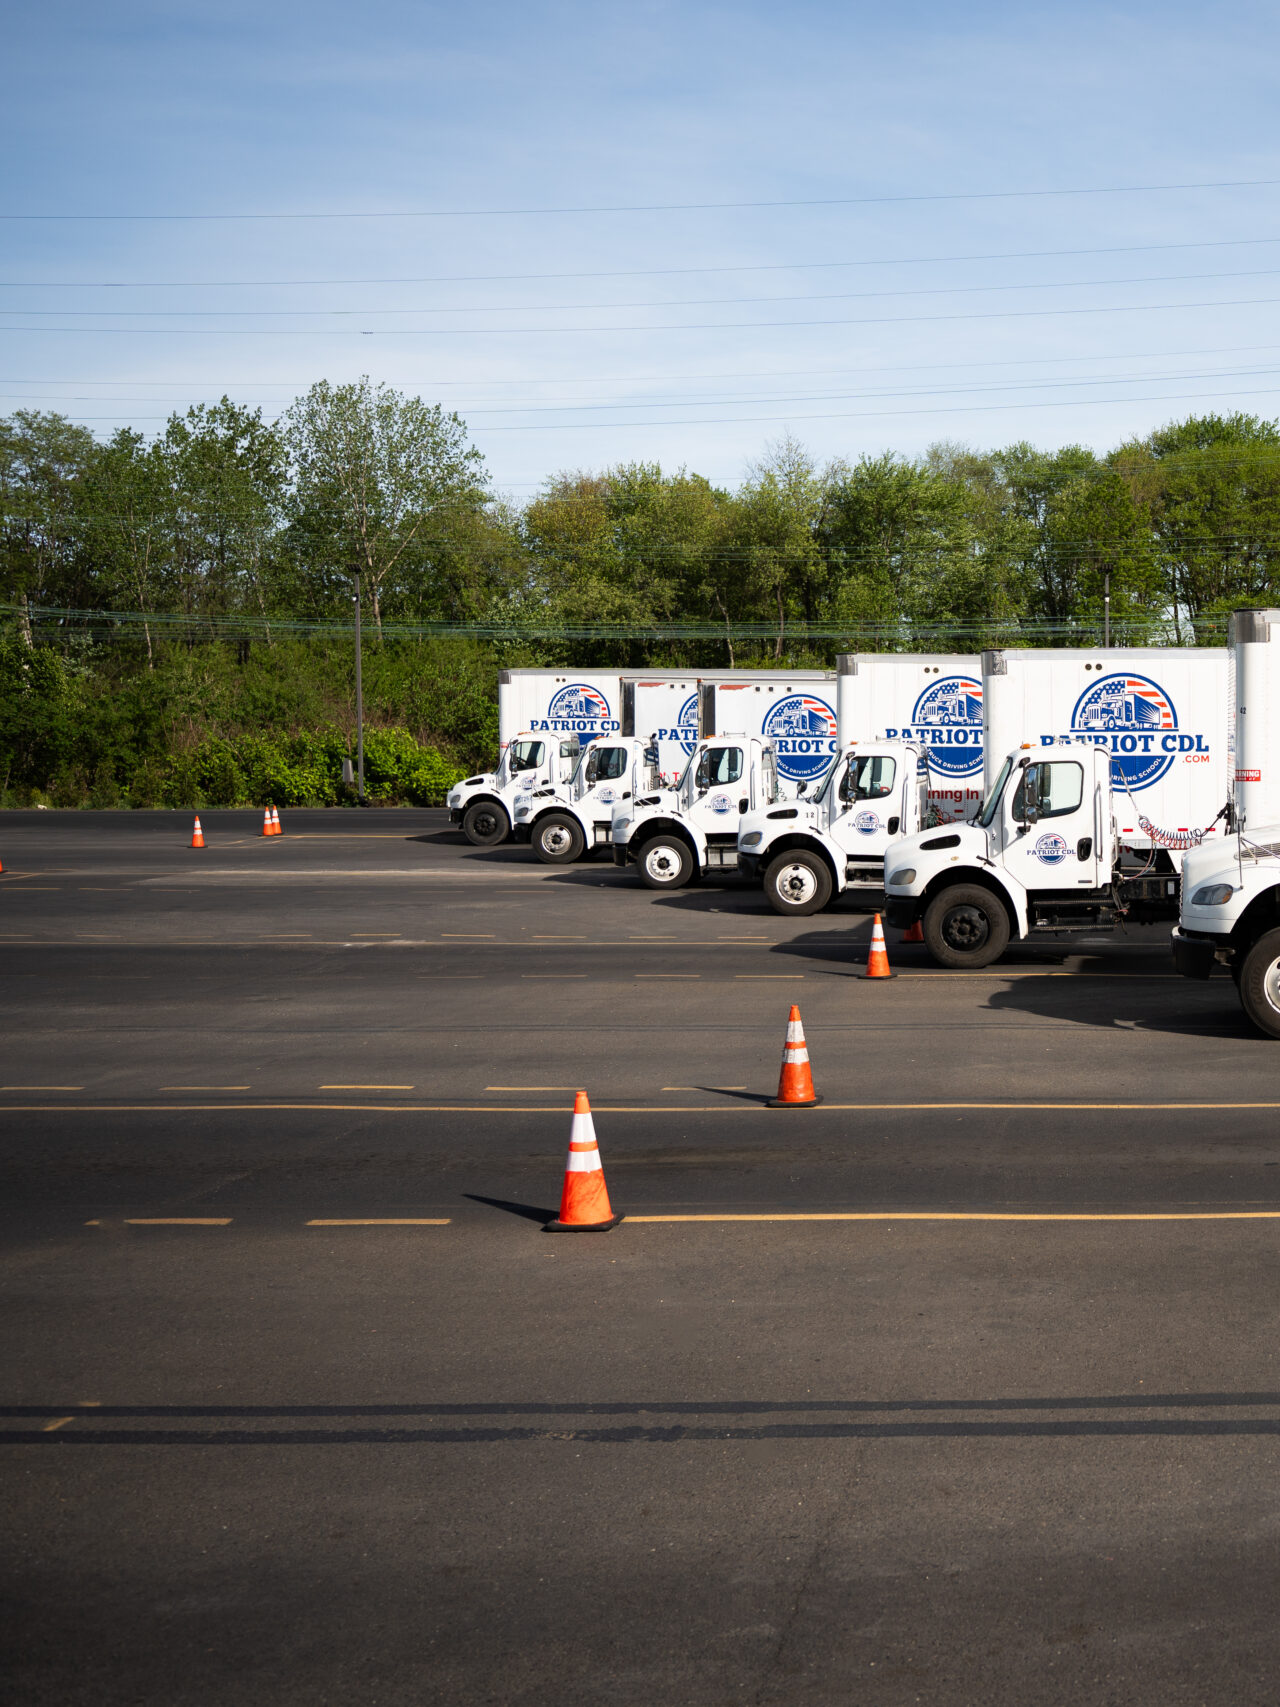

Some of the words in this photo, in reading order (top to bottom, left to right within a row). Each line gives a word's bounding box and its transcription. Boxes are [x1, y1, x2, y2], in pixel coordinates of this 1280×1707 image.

[530, 719, 597, 731] PATRIOT
[600, 719, 620, 731] CD
[658, 728, 699, 741] PATR
[1161, 734, 1210, 752] CDL
[1182, 754, 1210, 763] .COM
[942, 761, 968, 769] DRIVING
[1137, 758, 1162, 779] SCHOOL
[966, 787, 980, 801] In
[805, 811, 815, 819] 12
[991, 833, 996, 841] 5
